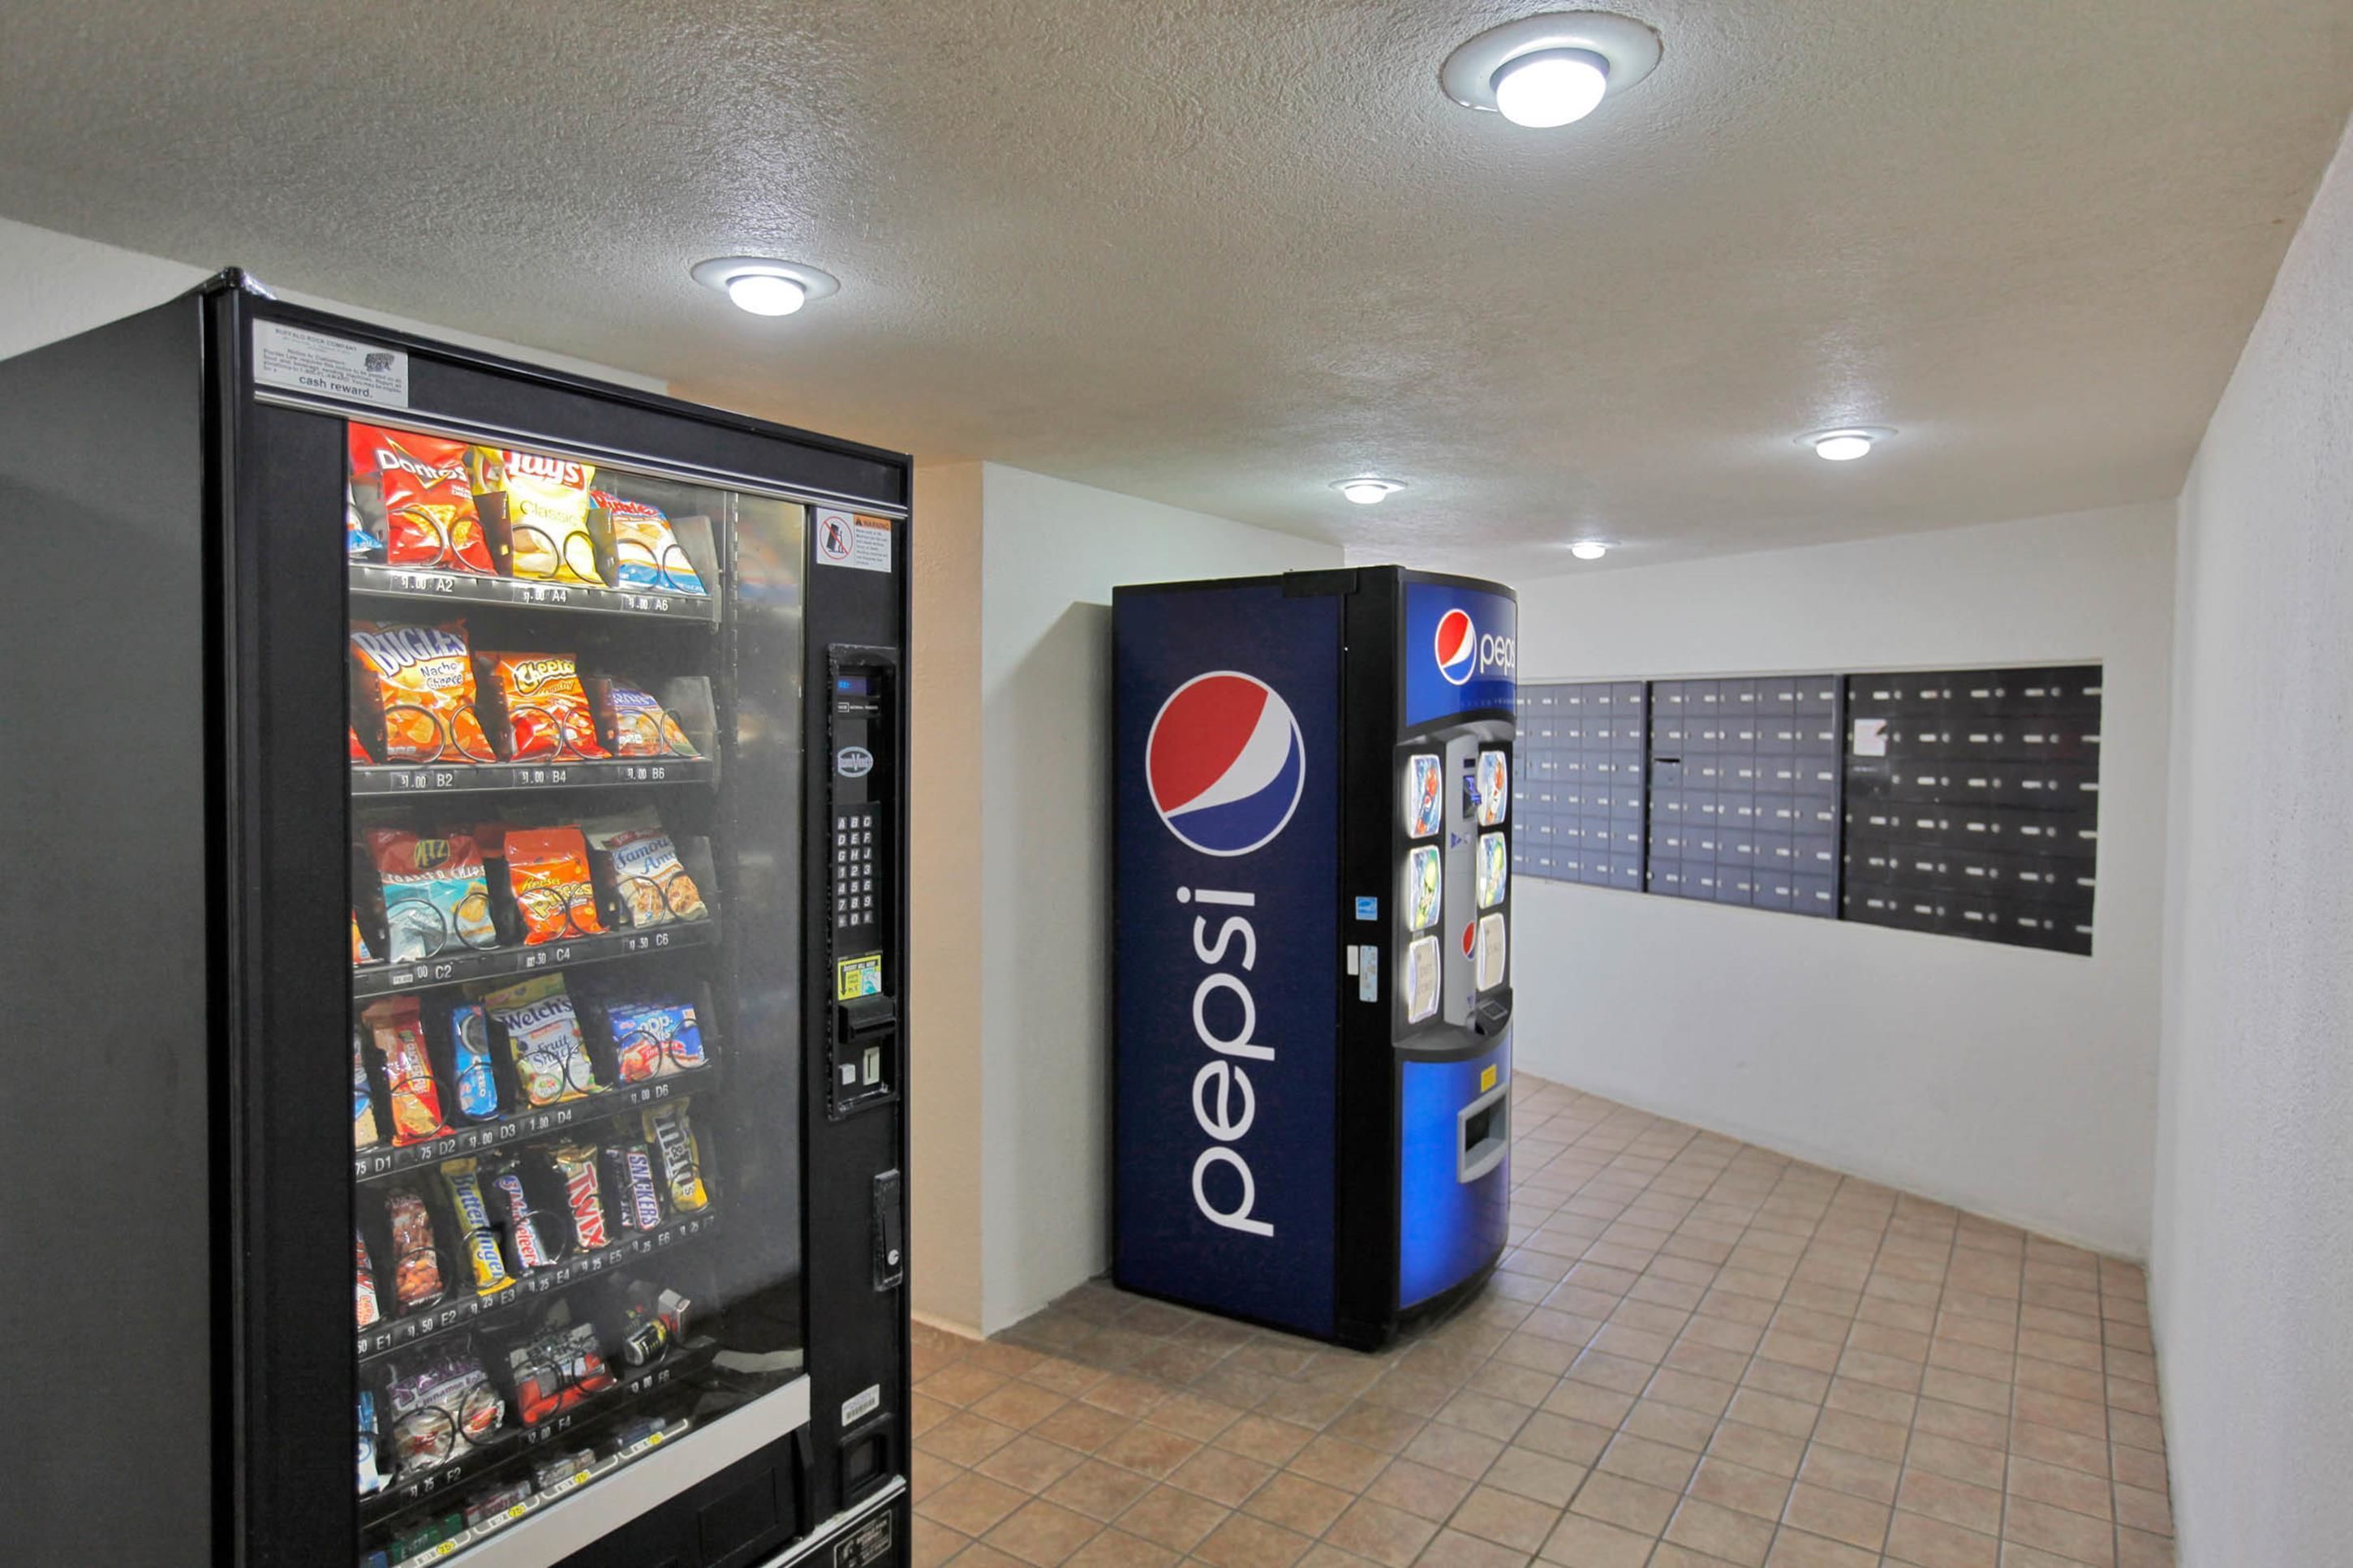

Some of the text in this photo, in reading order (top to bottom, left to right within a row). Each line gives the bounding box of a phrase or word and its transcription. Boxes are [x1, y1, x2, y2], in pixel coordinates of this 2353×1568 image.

[299, 375, 372, 398] cash reward.
[376, 449, 468, 483] Doritos
[520, 500, 580, 526] Classic
[436, 580, 454, 592] A2
[552, 590, 566, 603] A4
[656, 599, 669, 612] A6
[420, 661, 458, 677] Nacho
[426, 674, 463, 689] Cheese
[553, 771, 566, 783] B4
[652, 767, 665, 780] B6
[402, 775, 453, 788] $1.00 B2
[838, 818, 845, 829] A
[838, 832, 870, 846] D E F
[617, 837, 670, 870] Famou
[851, 849, 858, 860] H
[864, 848, 870, 859] J
[851, 866, 858, 876] 2
[864, 865, 870, 875] 3
[863, 880, 870, 891] 6
[838, 896, 870, 911] 7 8 9
[656, 934, 669, 946] C6
[557, 947, 570, 961] C4
[436, 964, 452, 980] C2
[505, 996, 572, 1031] Welch's
[536, 1034, 569, 1054] Fruit
[1175, 886, 1275, 1236] pepsi
[656, 1084, 669, 1098] D6
[557, 1110, 572, 1125] D4
[500, 1123, 516, 1139] D3
[439, 1140, 456, 1155] D2
[375, 1158, 392, 1173] D1
[628, 1153, 660, 1227] SNICKERS
[565, 1161, 608, 1248] TWIX
[658, 1231, 670, 1246] E6
[609, 1249, 622, 1264] E5
[557, 1270, 570, 1284] E4
[500, 1289, 515, 1304] E3
[441, 1310, 456, 1326] E2
[376, 1333, 391, 1351] E1
[446, 1466, 462, 1484] F2
